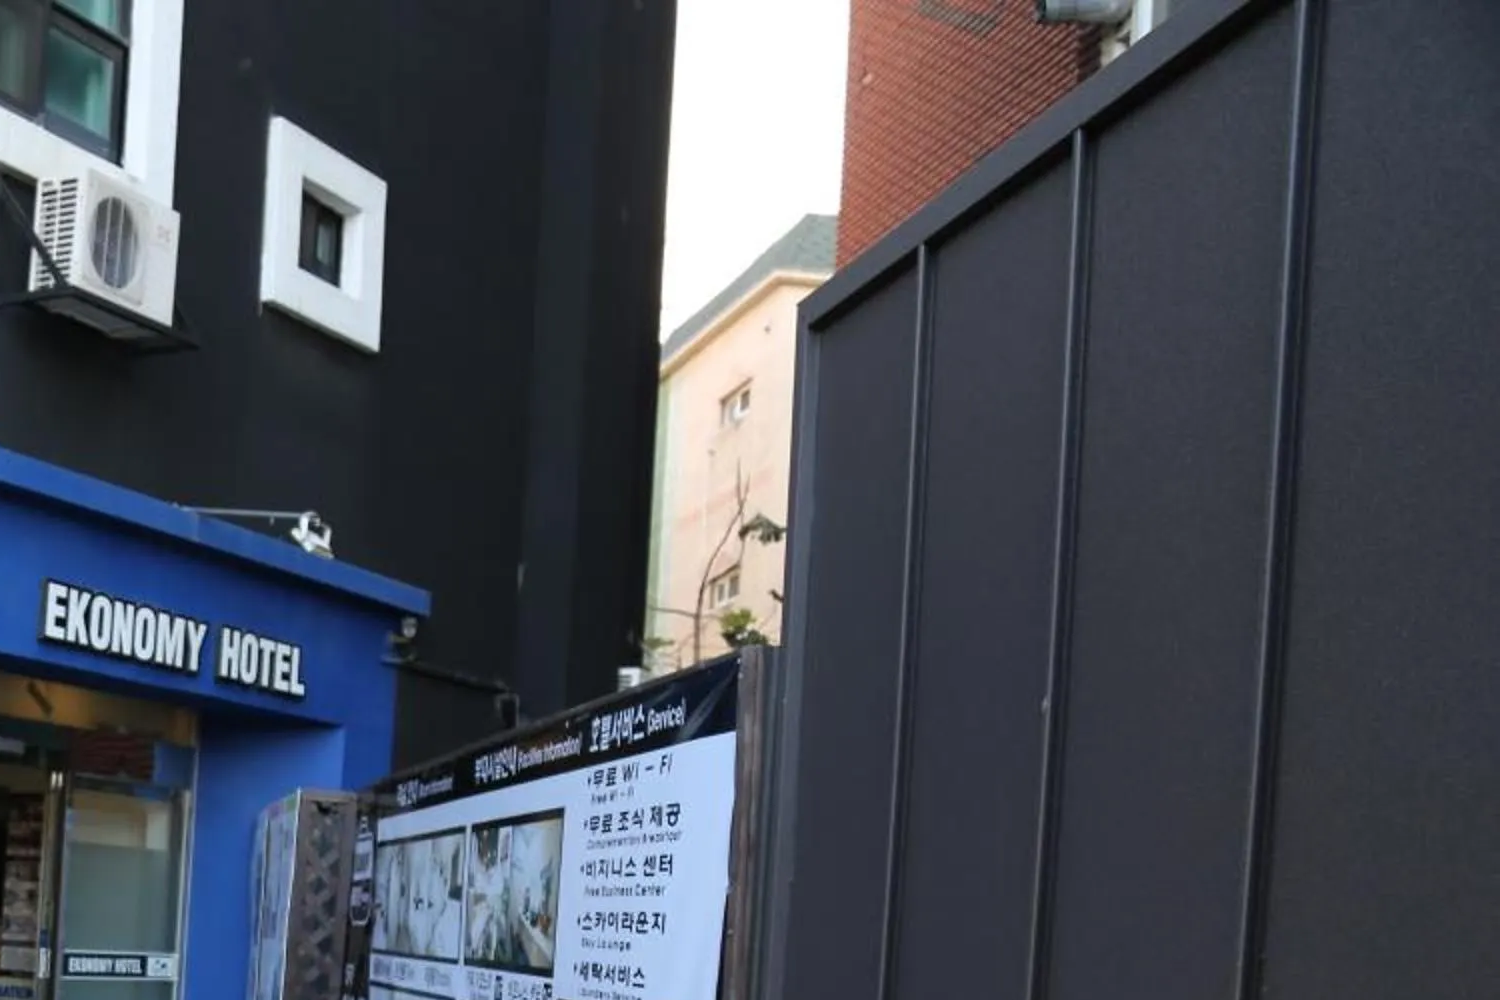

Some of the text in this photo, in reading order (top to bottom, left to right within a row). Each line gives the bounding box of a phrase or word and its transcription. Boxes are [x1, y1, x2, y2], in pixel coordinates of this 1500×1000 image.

[44, 581, 305, 697] EKONOMY HOTEL
[589, 703, 645, 753] 호텔서비스
[593, 767, 617, 789] 무료
[589, 803, 681, 835] 무료 조식 제공
[585, 853, 673, 880] 비지니스 센터
[581, 911, 667, 935] 스카이라운지
[579, 961, 645, 989] 세탁서비스
